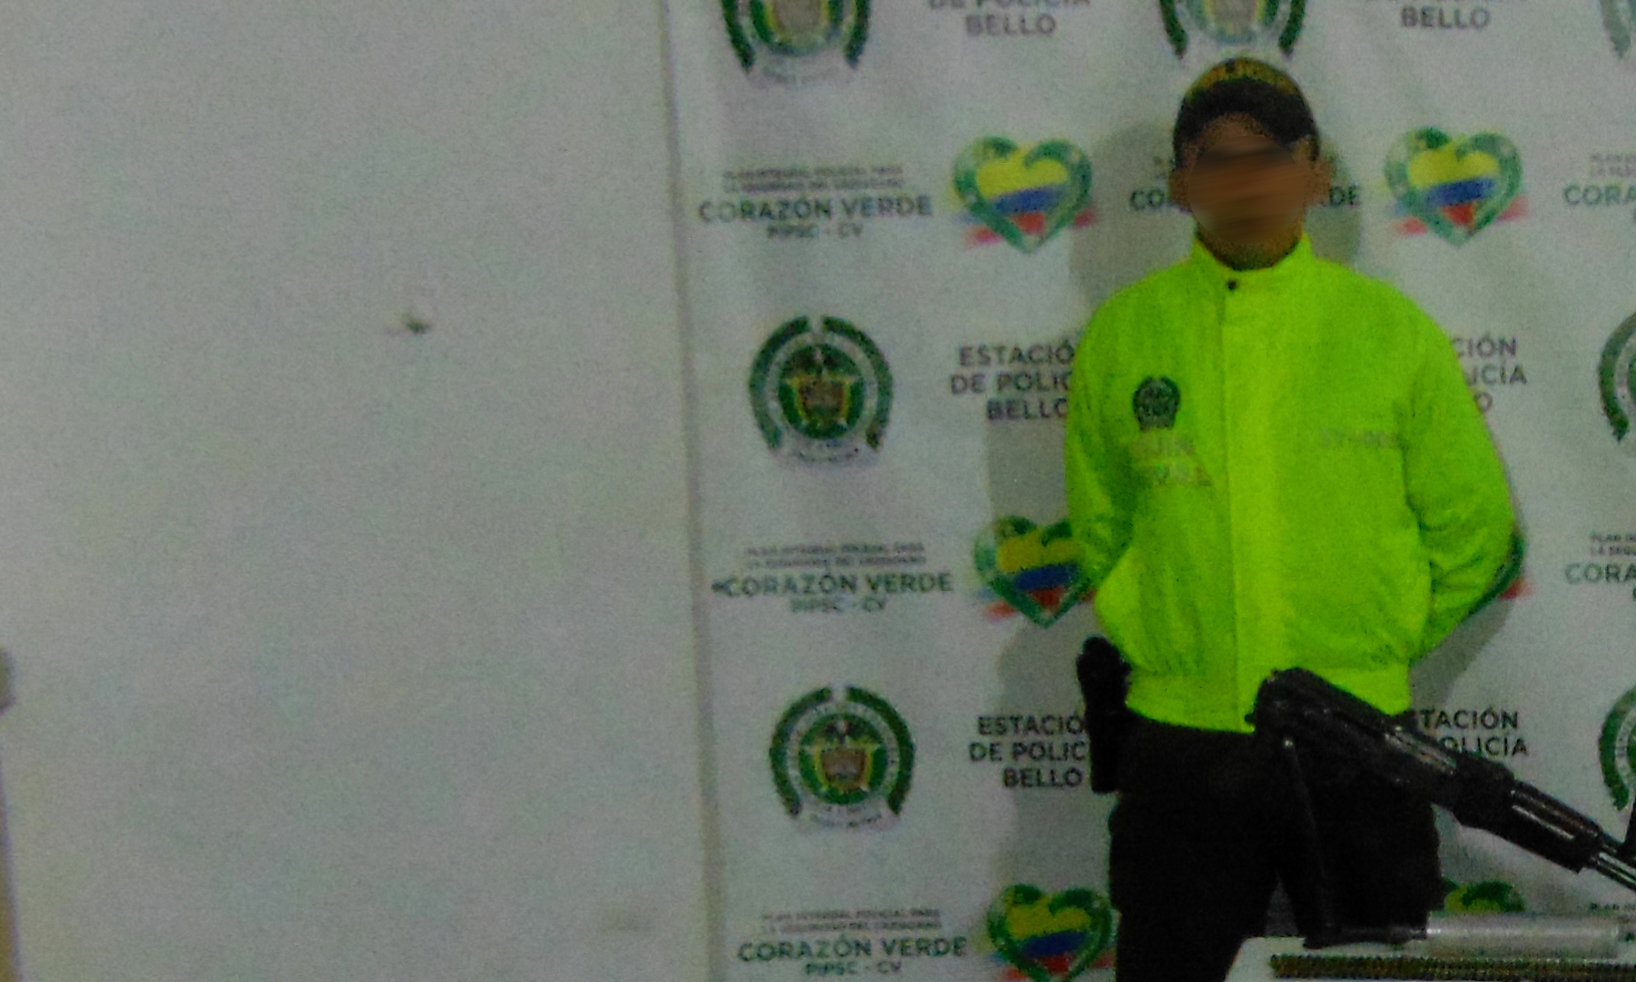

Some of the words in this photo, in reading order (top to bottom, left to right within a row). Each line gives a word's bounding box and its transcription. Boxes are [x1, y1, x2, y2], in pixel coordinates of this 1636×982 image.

[966, 13, 1056, 36] BELLO
[1401, 6, 1490, 29] BELLO
[699, 193, 832, 222] CORAZÓN
[840, 193, 933, 217] VERDE
[950, 373, 986, 394] DE
[968, 741, 1004, 763] DE
[1010, 740, 1087, 762] POLIC
[1002, 765, 1084, 788] BELLO
[736, 930, 873, 964] CORAZÓN
[880, 934, 968, 958] VERDE
